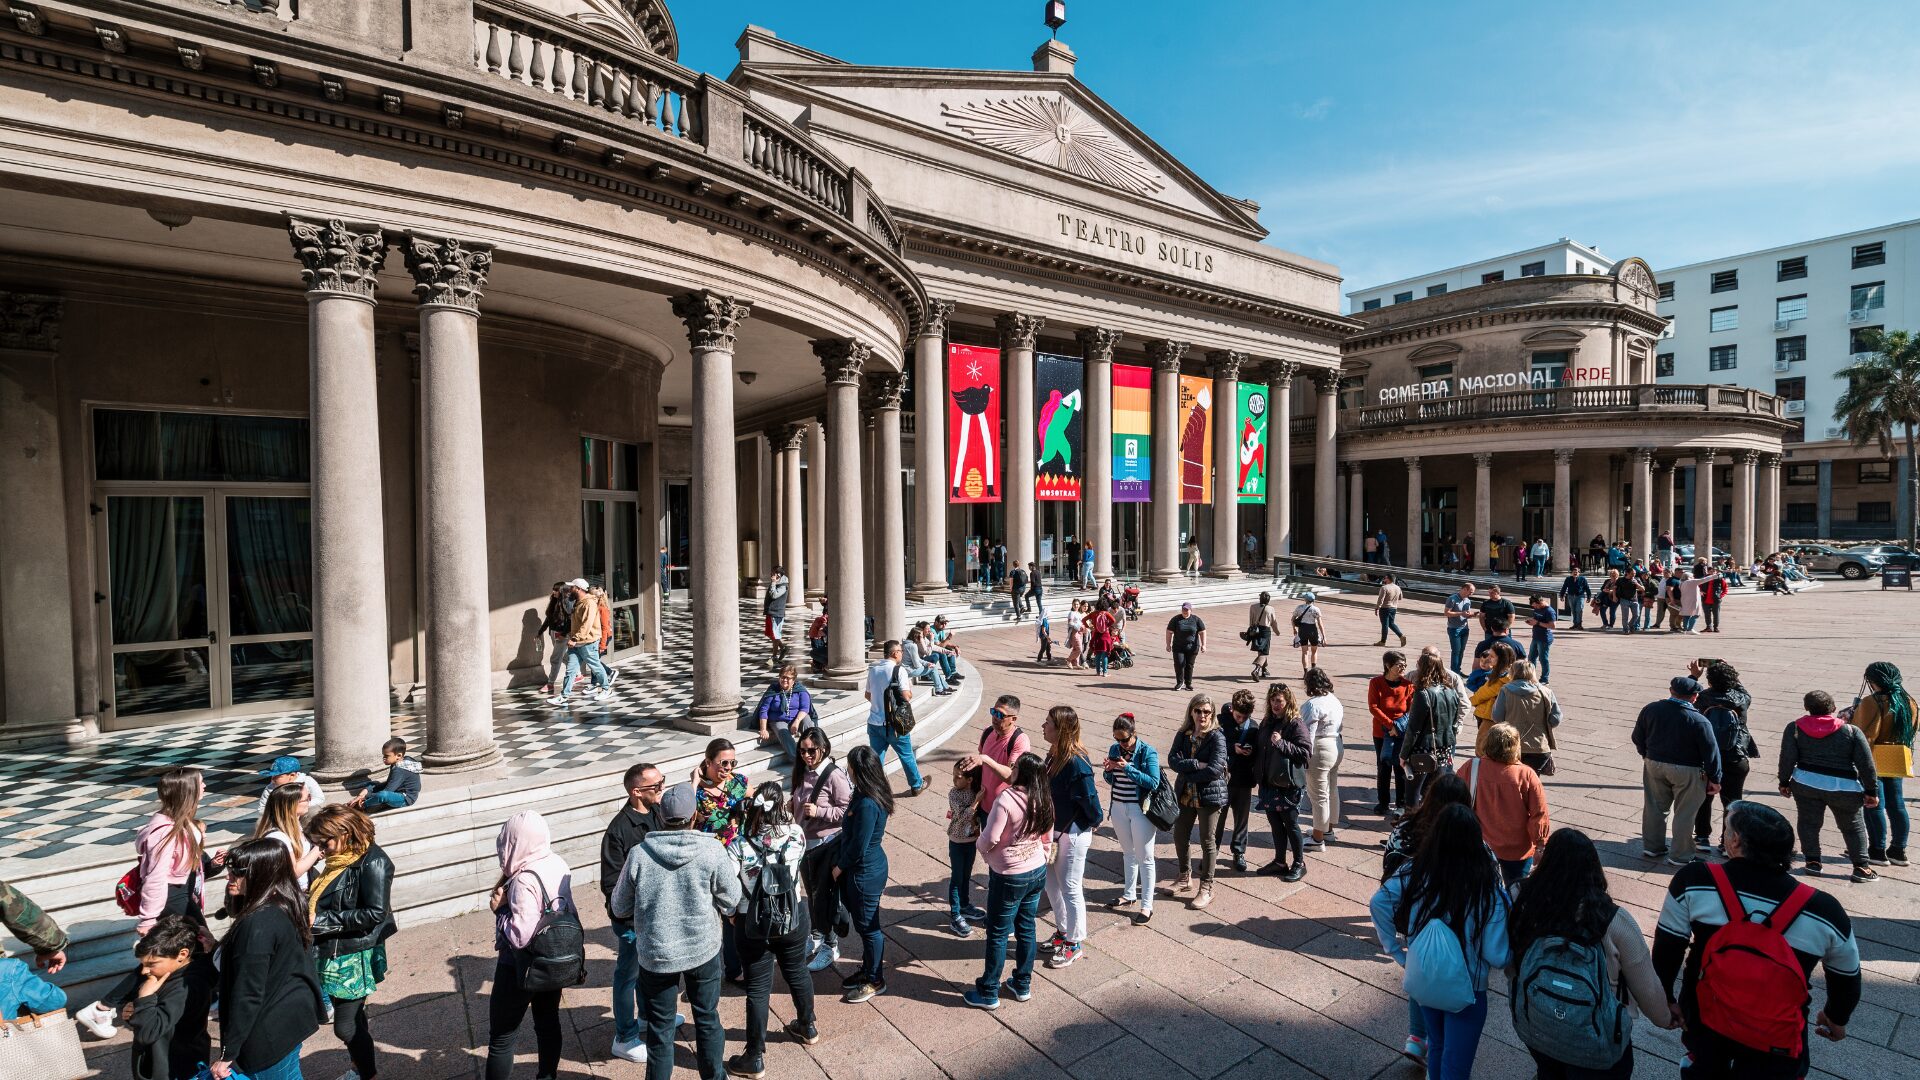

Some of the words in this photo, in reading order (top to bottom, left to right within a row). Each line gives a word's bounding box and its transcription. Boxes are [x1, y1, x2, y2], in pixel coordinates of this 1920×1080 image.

[1057, 213, 1146, 255] TEATRO
[1158, 241, 1214, 273] SOLIS
[1378, 379, 1449, 400] COMEDIA
[1459, 369, 1556, 391] NACIONAL
[1561, 367, 1611, 382] ARDE
[1039, 489, 1076, 497] NOSOTRAS
